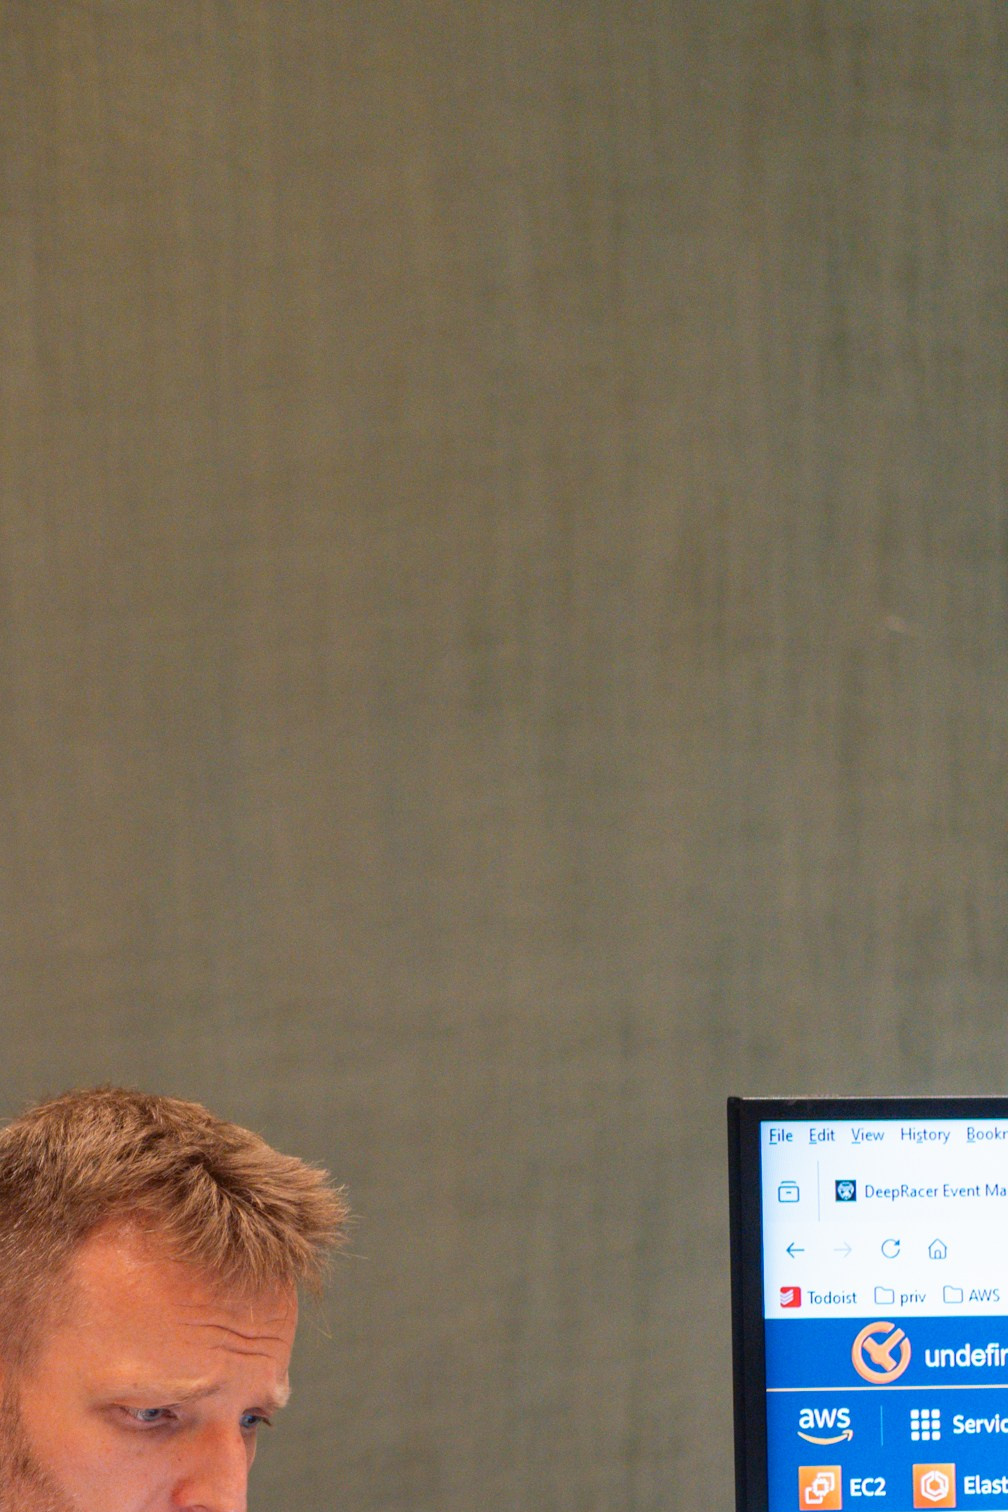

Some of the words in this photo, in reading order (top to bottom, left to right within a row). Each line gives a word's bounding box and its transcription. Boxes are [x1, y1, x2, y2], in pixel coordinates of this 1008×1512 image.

[769, 1128, 793, 1144] File
[809, 1128, 835, 1143] Edit
[852, 1127, 884, 1143] View
[900, 1126, 950, 1144] History
[865, 1184, 938, 1201] DeepRacer
[943, 1183, 980, 1197] Event
[808, 1290, 857, 1304] Todoist
[900, 1291, 926, 1307] priv
[969, 1288, 1000, 1302] AWS
[798, 1407, 851, 1429] aws
[849, 1477, 887, 1497] EC2
